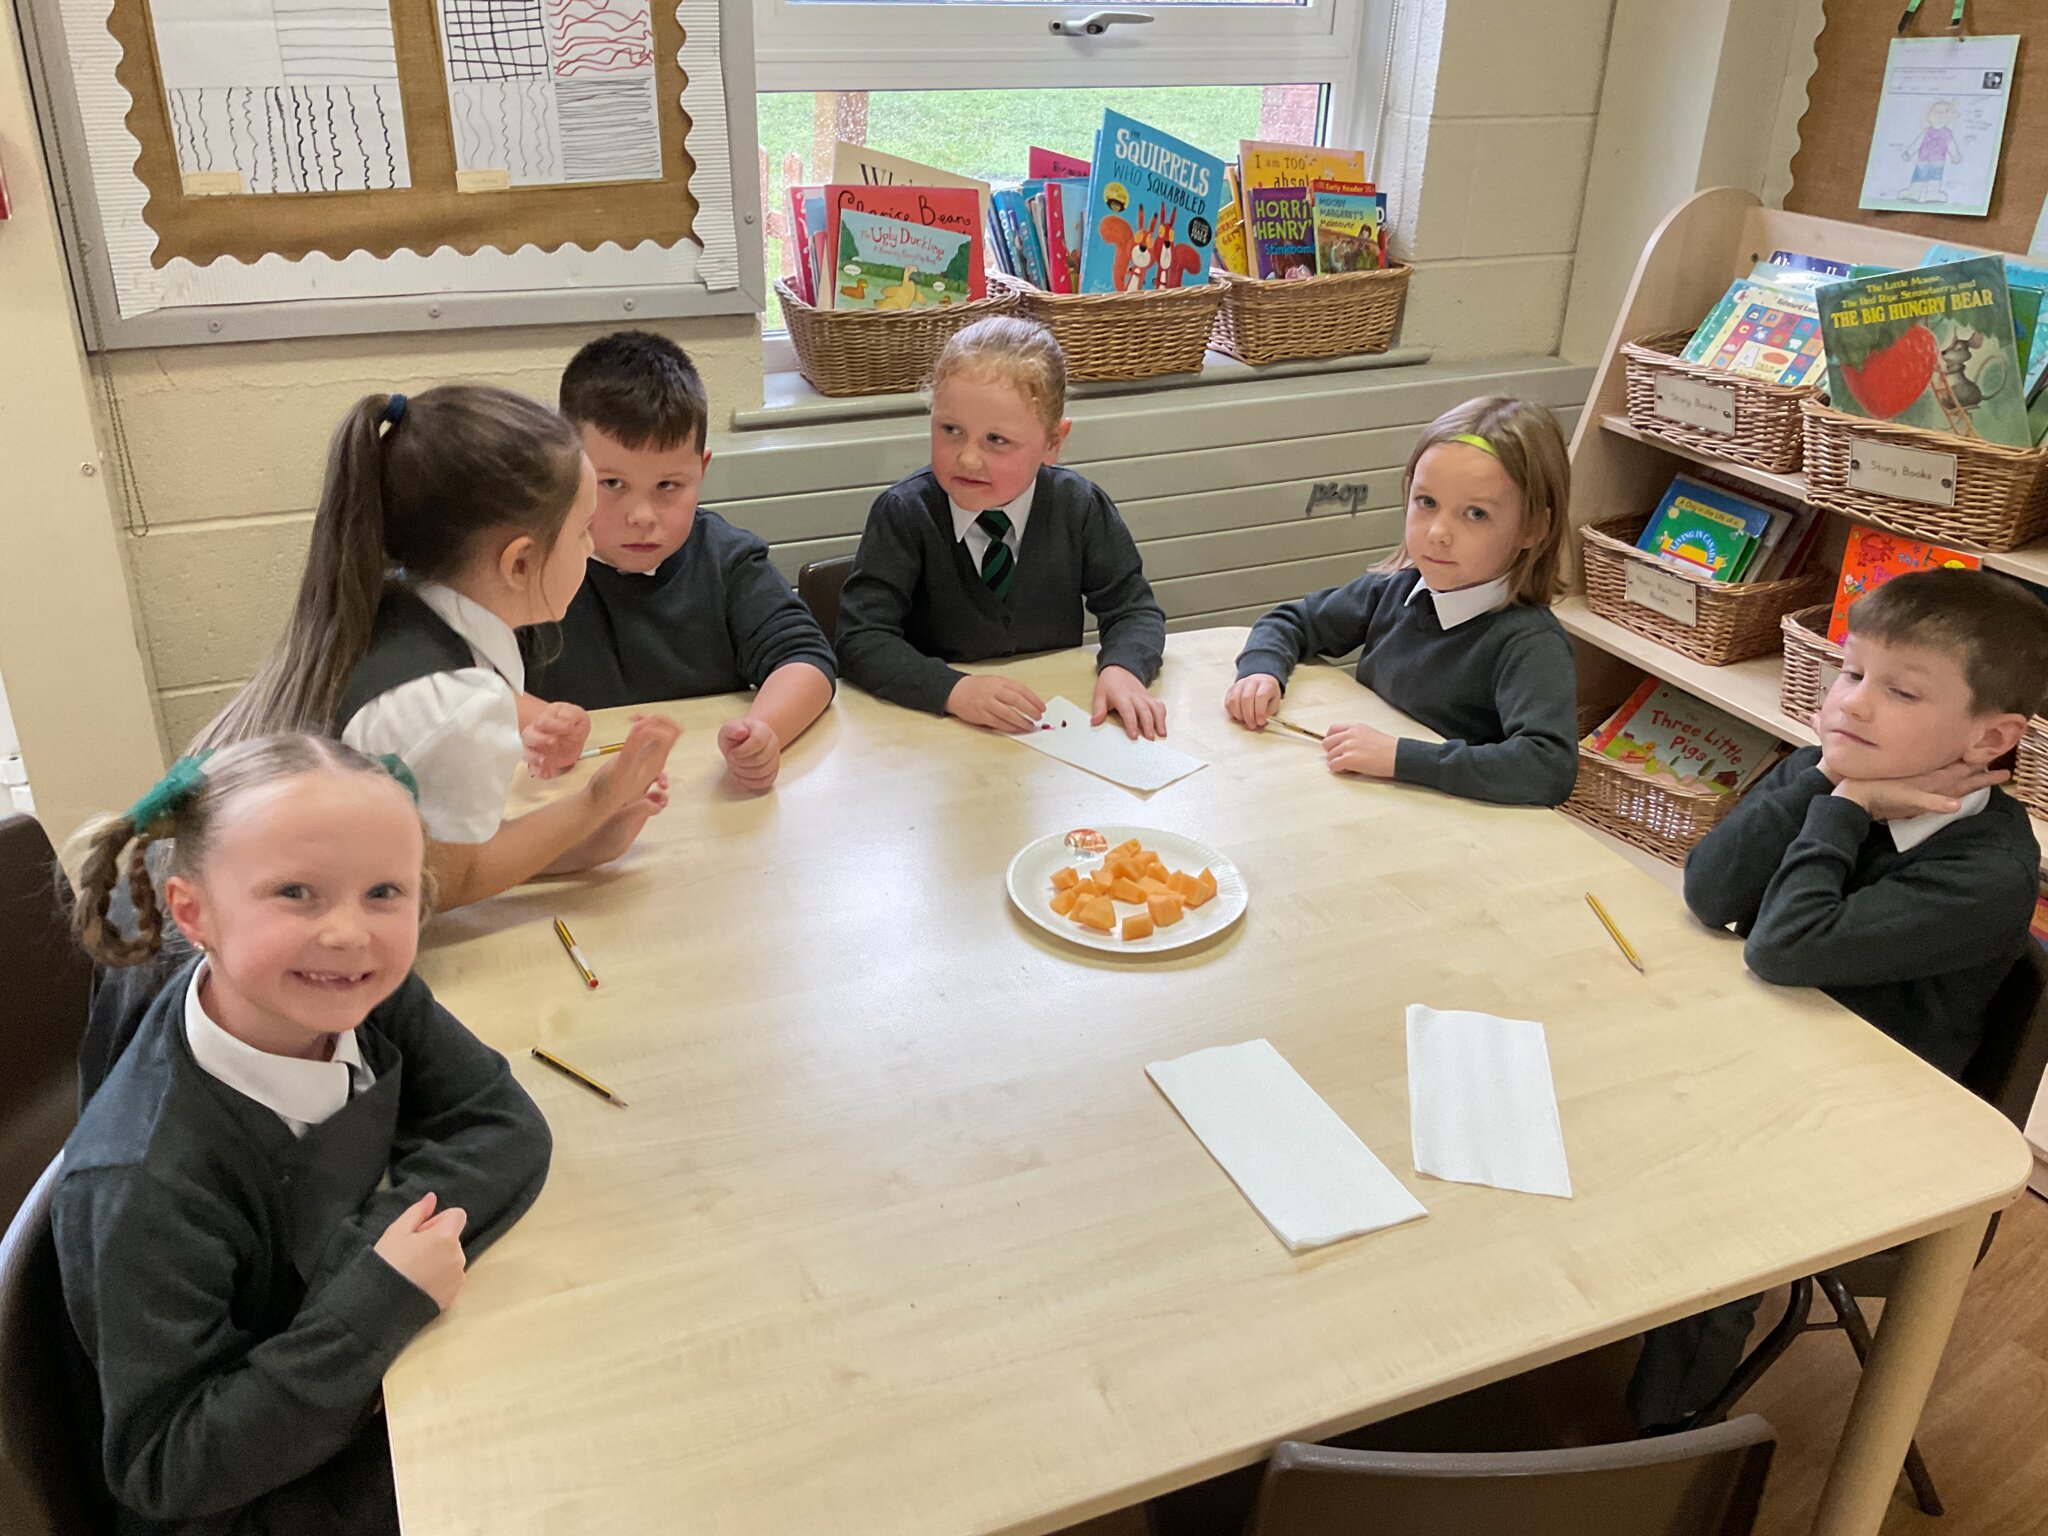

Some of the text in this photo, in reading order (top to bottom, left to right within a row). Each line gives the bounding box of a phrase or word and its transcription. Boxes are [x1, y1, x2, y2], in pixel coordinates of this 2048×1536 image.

[1115, 128, 1210, 197] SQUIRRELS
[1113, 161, 1142, 186] WHO
[1147, 172, 1206, 215] SQUABBLED
[871, 226, 898, 248] Ugly
[900, 227, 945, 261] Duckling
[1865, 284, 1882, 293] The
[1885, 279, 1909, 290] Little
[1831, 288, 1994, 329] THE BIG HUNGRY BEAR
[1841, 299, 1857, 308] The
[1871, 460, 1932, 480] Story Books
[1670, 530, 1716, 564] LIVING IN CANADA
[1652, 709, 1743, 765] Three Little
[1669, 736, 1707, 762] Pigs
